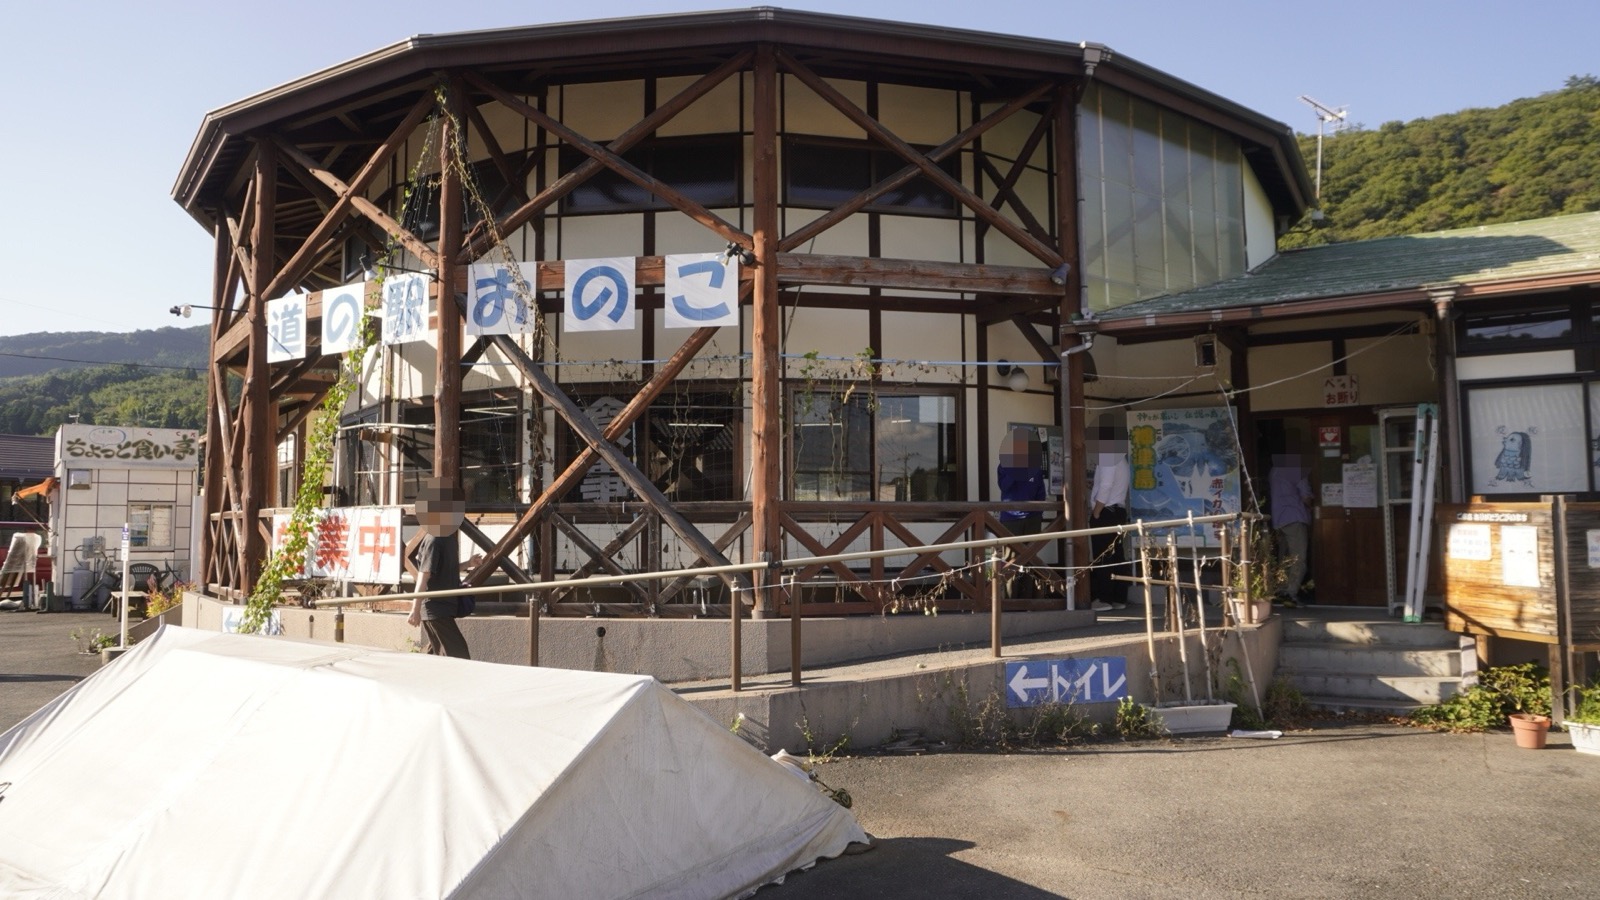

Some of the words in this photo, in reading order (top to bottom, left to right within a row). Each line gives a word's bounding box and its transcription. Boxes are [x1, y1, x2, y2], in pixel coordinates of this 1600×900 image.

[271, 280, 423, 355] 道の駅
[472, 259, 731, 325] おのこ
[1326, 391, 1358, 404] お断り
[66, 434, 196, 460] ちょっと食い亭
[277, 515, 397, 575] 業中
[1051, 662, 1127, 703] トイレ
